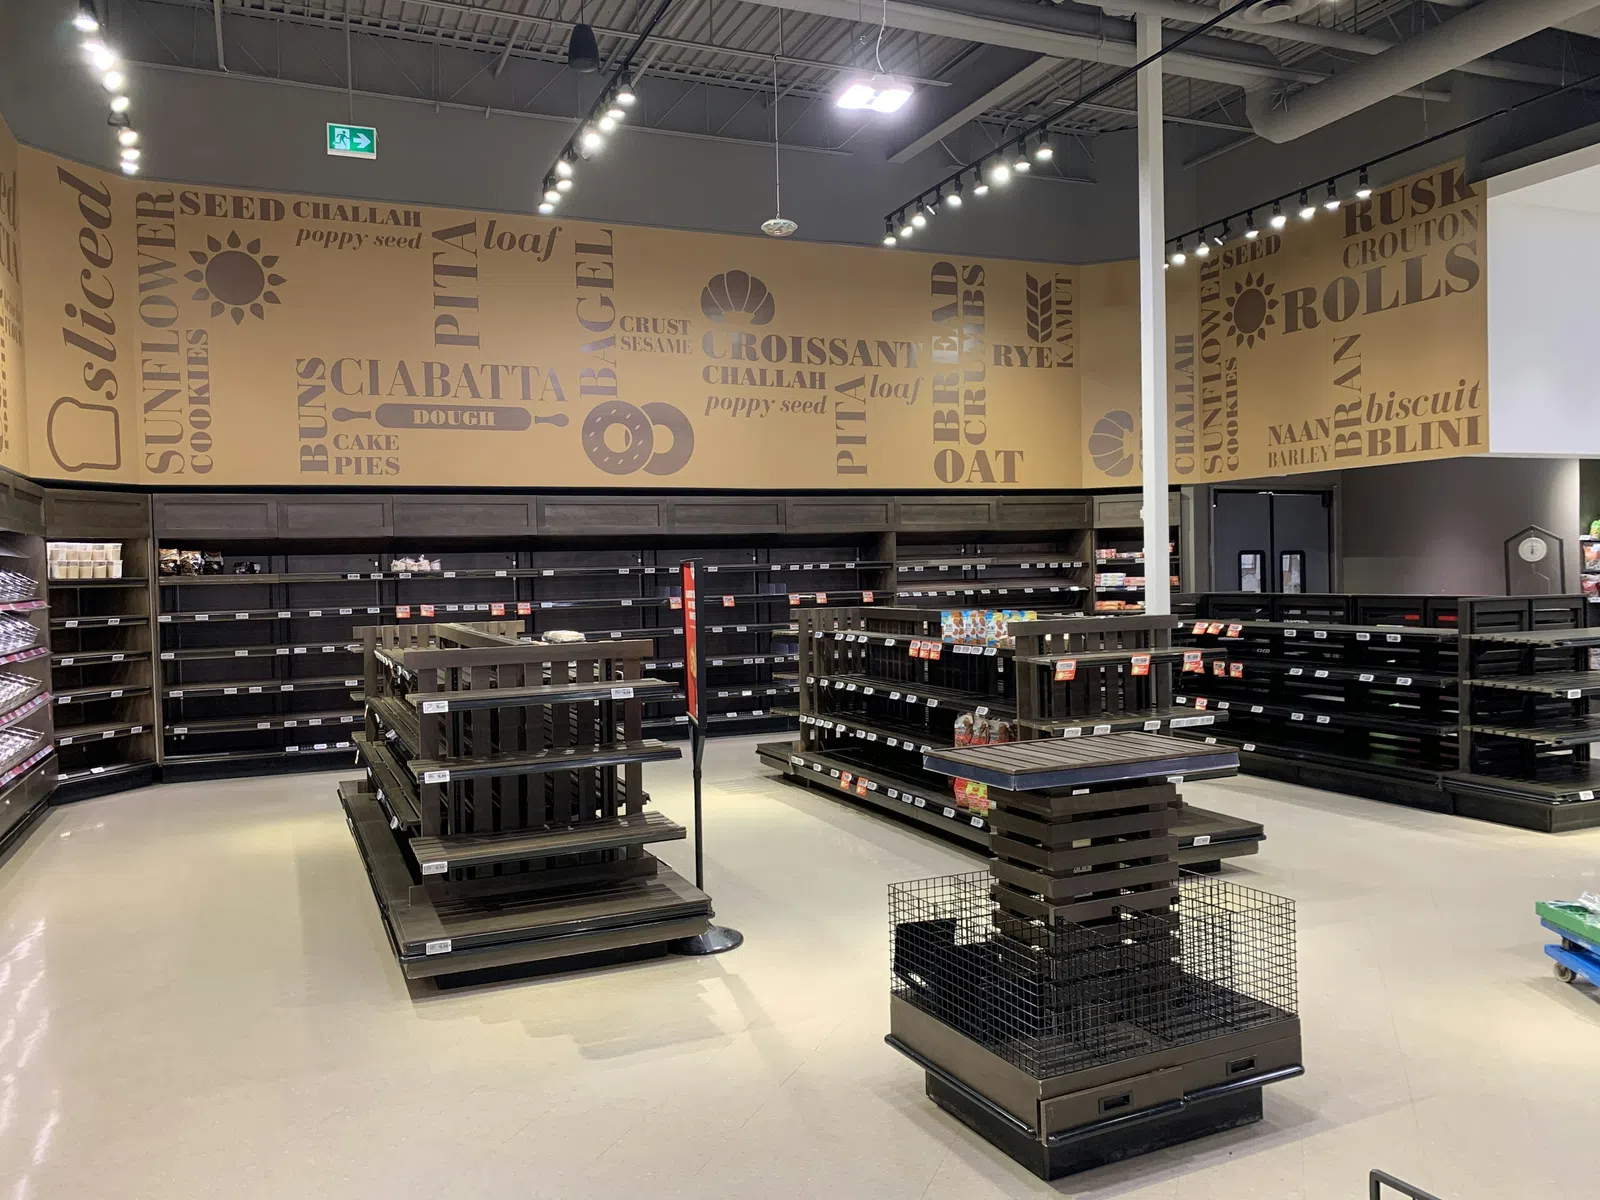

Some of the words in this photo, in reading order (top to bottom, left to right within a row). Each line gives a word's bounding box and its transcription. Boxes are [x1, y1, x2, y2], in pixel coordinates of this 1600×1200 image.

[179, 189, 286, 222] SEED
[292, 200, 423, 229] CHALLAH
[1343, 166, 1480, 240] RUSK
[293, 228, 369, 251] poppy
[373, 232, 424, 250] seed
[483, 219, 563, 263] loaf
[1222, 234, 1282, 271] SEED
[1342, 205, 1480, 270] CROUTON
[57, 166, 119, 402] sliced
[431, 218, 480, 350] PITA
[1281, 240, 1481, 336] ROLLS
[135, 188, 186, 475] SUNFLOWER
[574, 228, 619, 399] BAGEL
[619, 315, 692, 337] CRUST
[1055, 272, 1074, 369] KAMUT
[620, 335, 694, 355] SESAME
[701, 329, 924, 369] CROISSANT
[931, 260, 961, 445] BREAD
[961, 263, 987, 446] CRUMBS
[992, 343, 1053, 370] RYE
[1200, 254, 1223, 475] SUNFLOWER
[330, 357, 569, 402] CIABATTA
[701, 364, 827, 391] CHALLAH
[868, 373, 925, 406] loaf
[1332, 332, 1363, 460] BRAN
[185, 327, 215, 475] COOKIES
[296, 356, 330, 475] BUNS
[412, 408, 497, 427] DOUGH
[704, 395, 777, 419] poppy
[779, 395, 828, 415] seed
[1174, 332, 1196, 475] CHALLAH
[1225, 356, 1240, 472] COOKIES
[1365, 378, 1481, 424] biscuit
[332, 433, 400, 452] CAKE
[834, 373, 869, 477] PITA
[1267, 416, 1332, 447] NAAN
[1365, 415, 1482, 458] BLINI
[333, 456, 401, 476] PIES
[933, 448, 1024, 484] OAT
[1267, 445, 1333, 469] BARLEY
